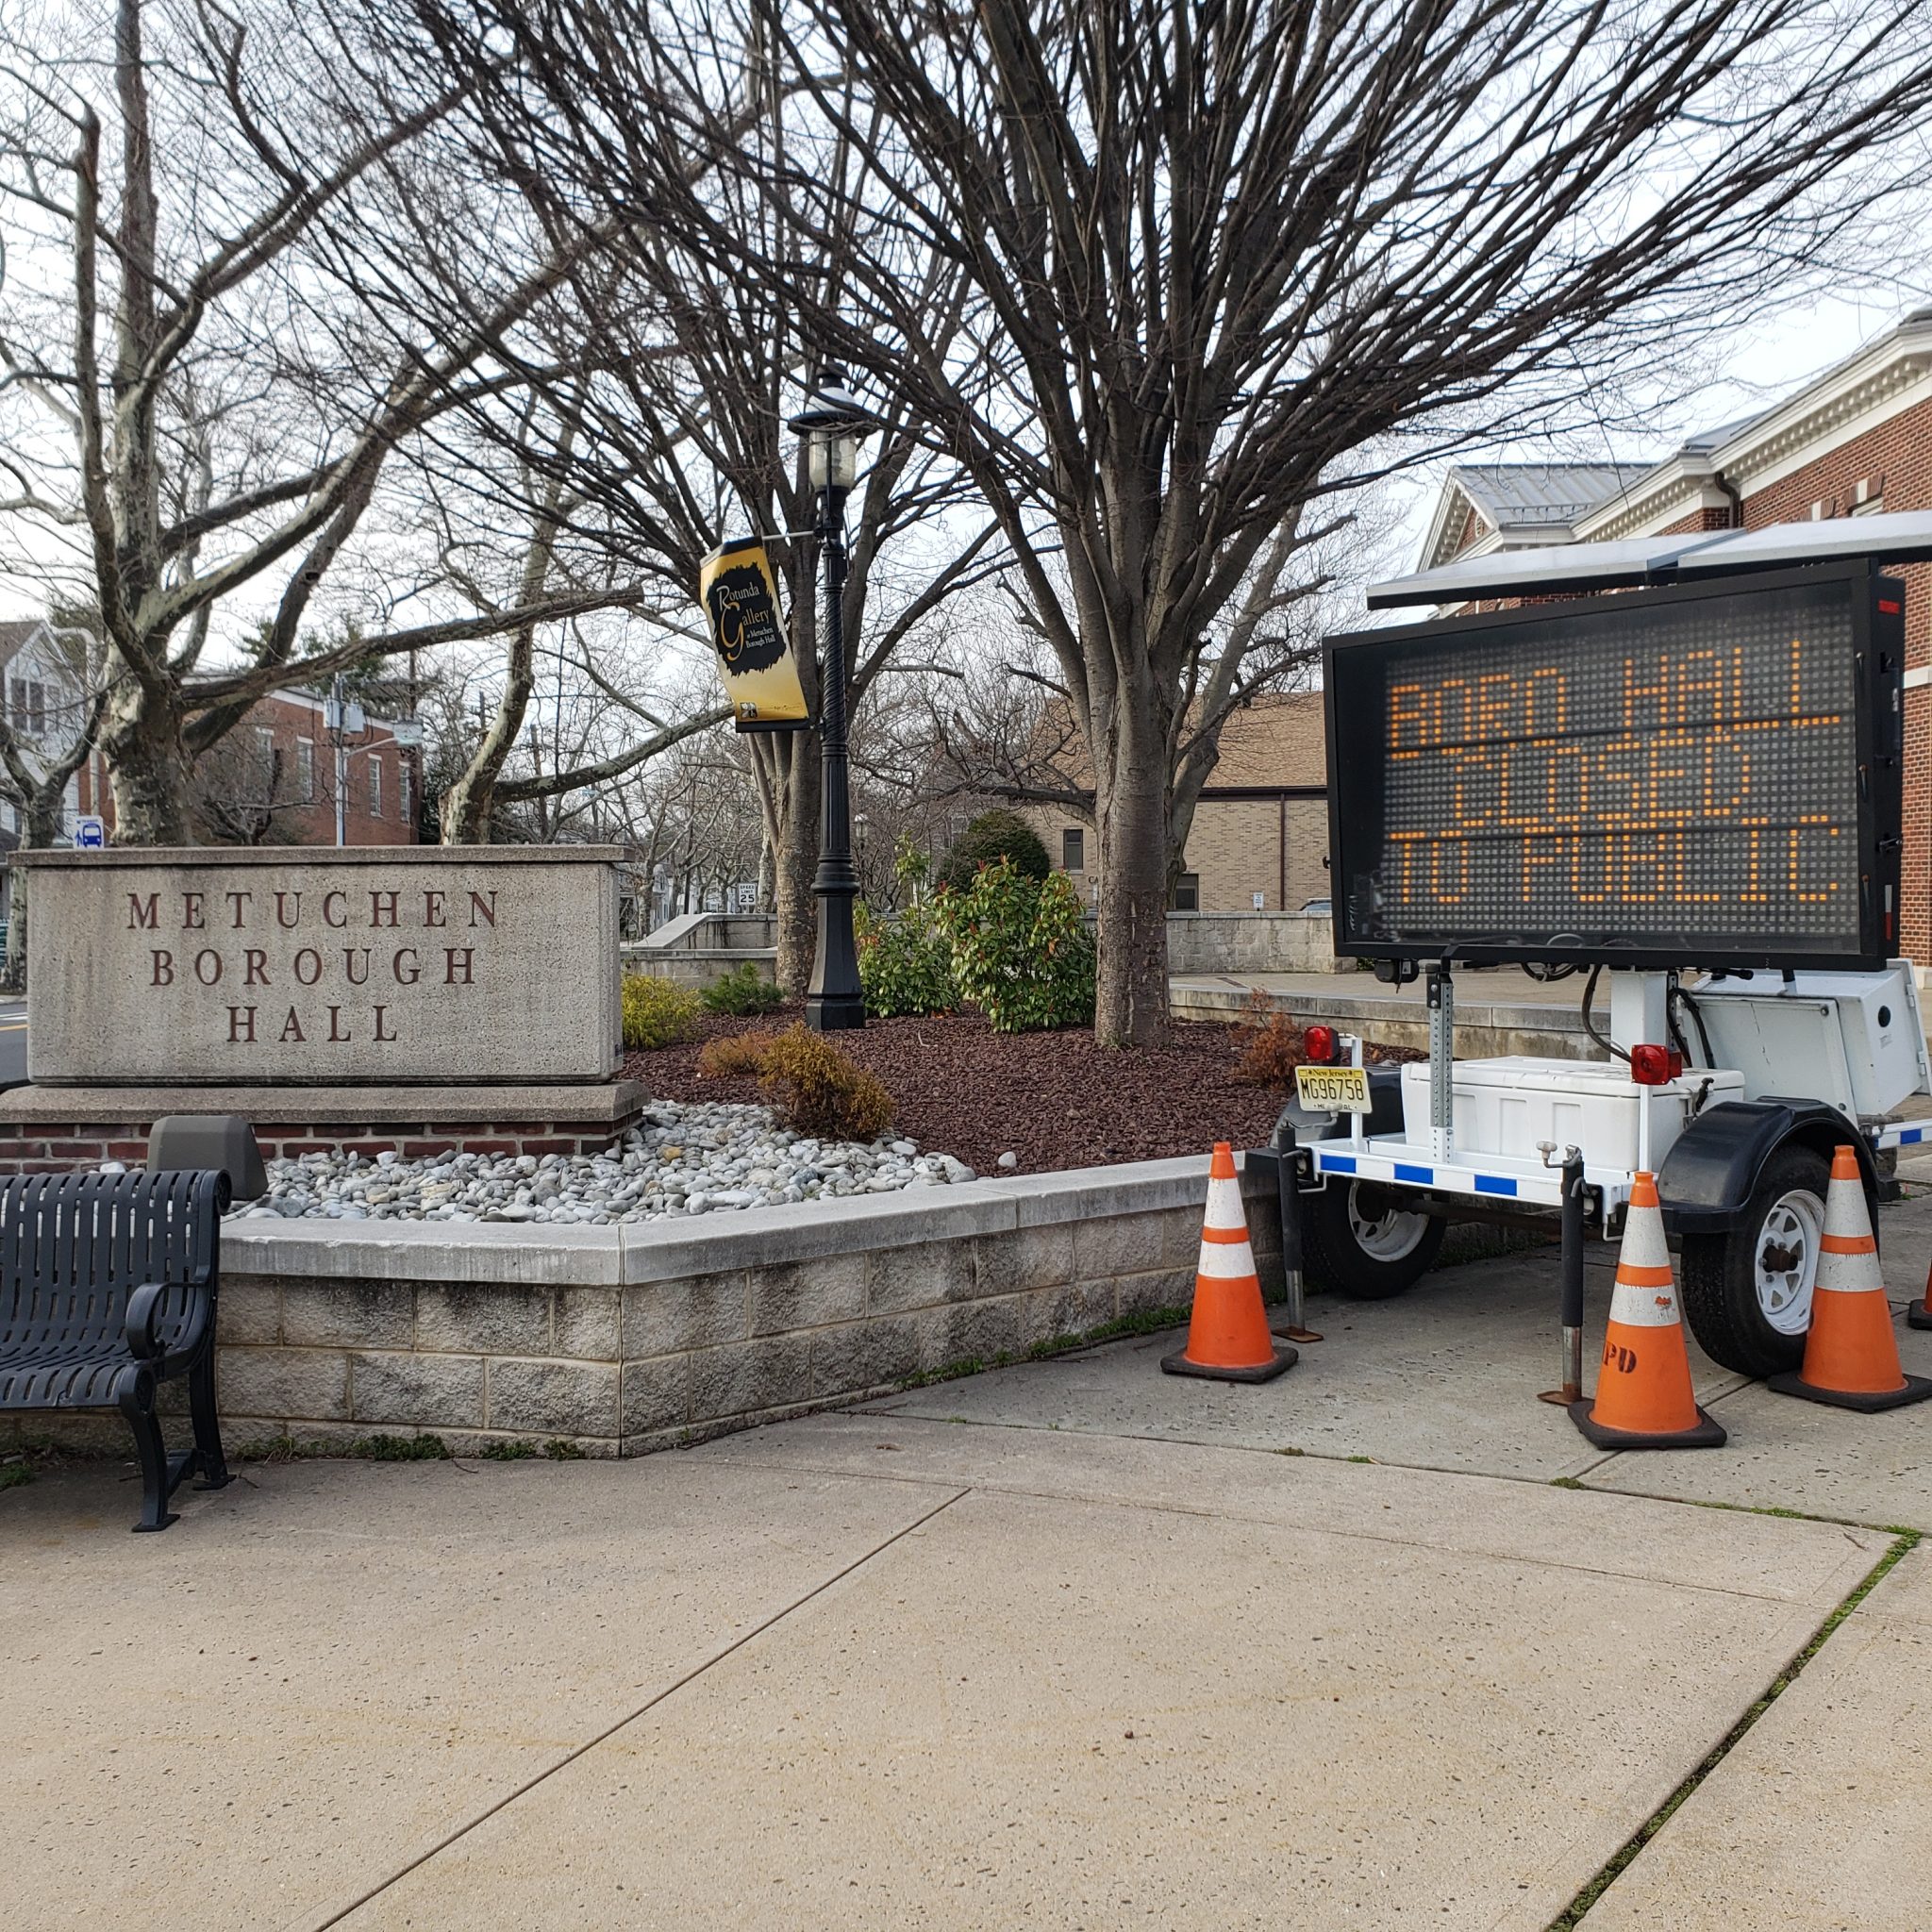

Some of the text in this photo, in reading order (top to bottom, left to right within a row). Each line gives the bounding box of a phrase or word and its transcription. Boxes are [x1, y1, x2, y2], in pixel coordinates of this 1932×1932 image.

[716, 582, 760, 611] Rotunda
[721, 602, 770, 660] Gallery
[1391, 641, 1840, 758] BORO HALL
[1455, 735, 1751, 827] CLOSED
[1390, 815, 1839, 903] TO PUBLIC
[127, 890, 499, 930] METUCHEN
[740, 894, 755, 903] 25
[150, 947, 476, 987] BOROUGH
[226, 1005, 398, 1043] HALL
[1300, 1077, 1364, 1101] MG96758
[1328, 1069, 1348, 1077] Jersey
